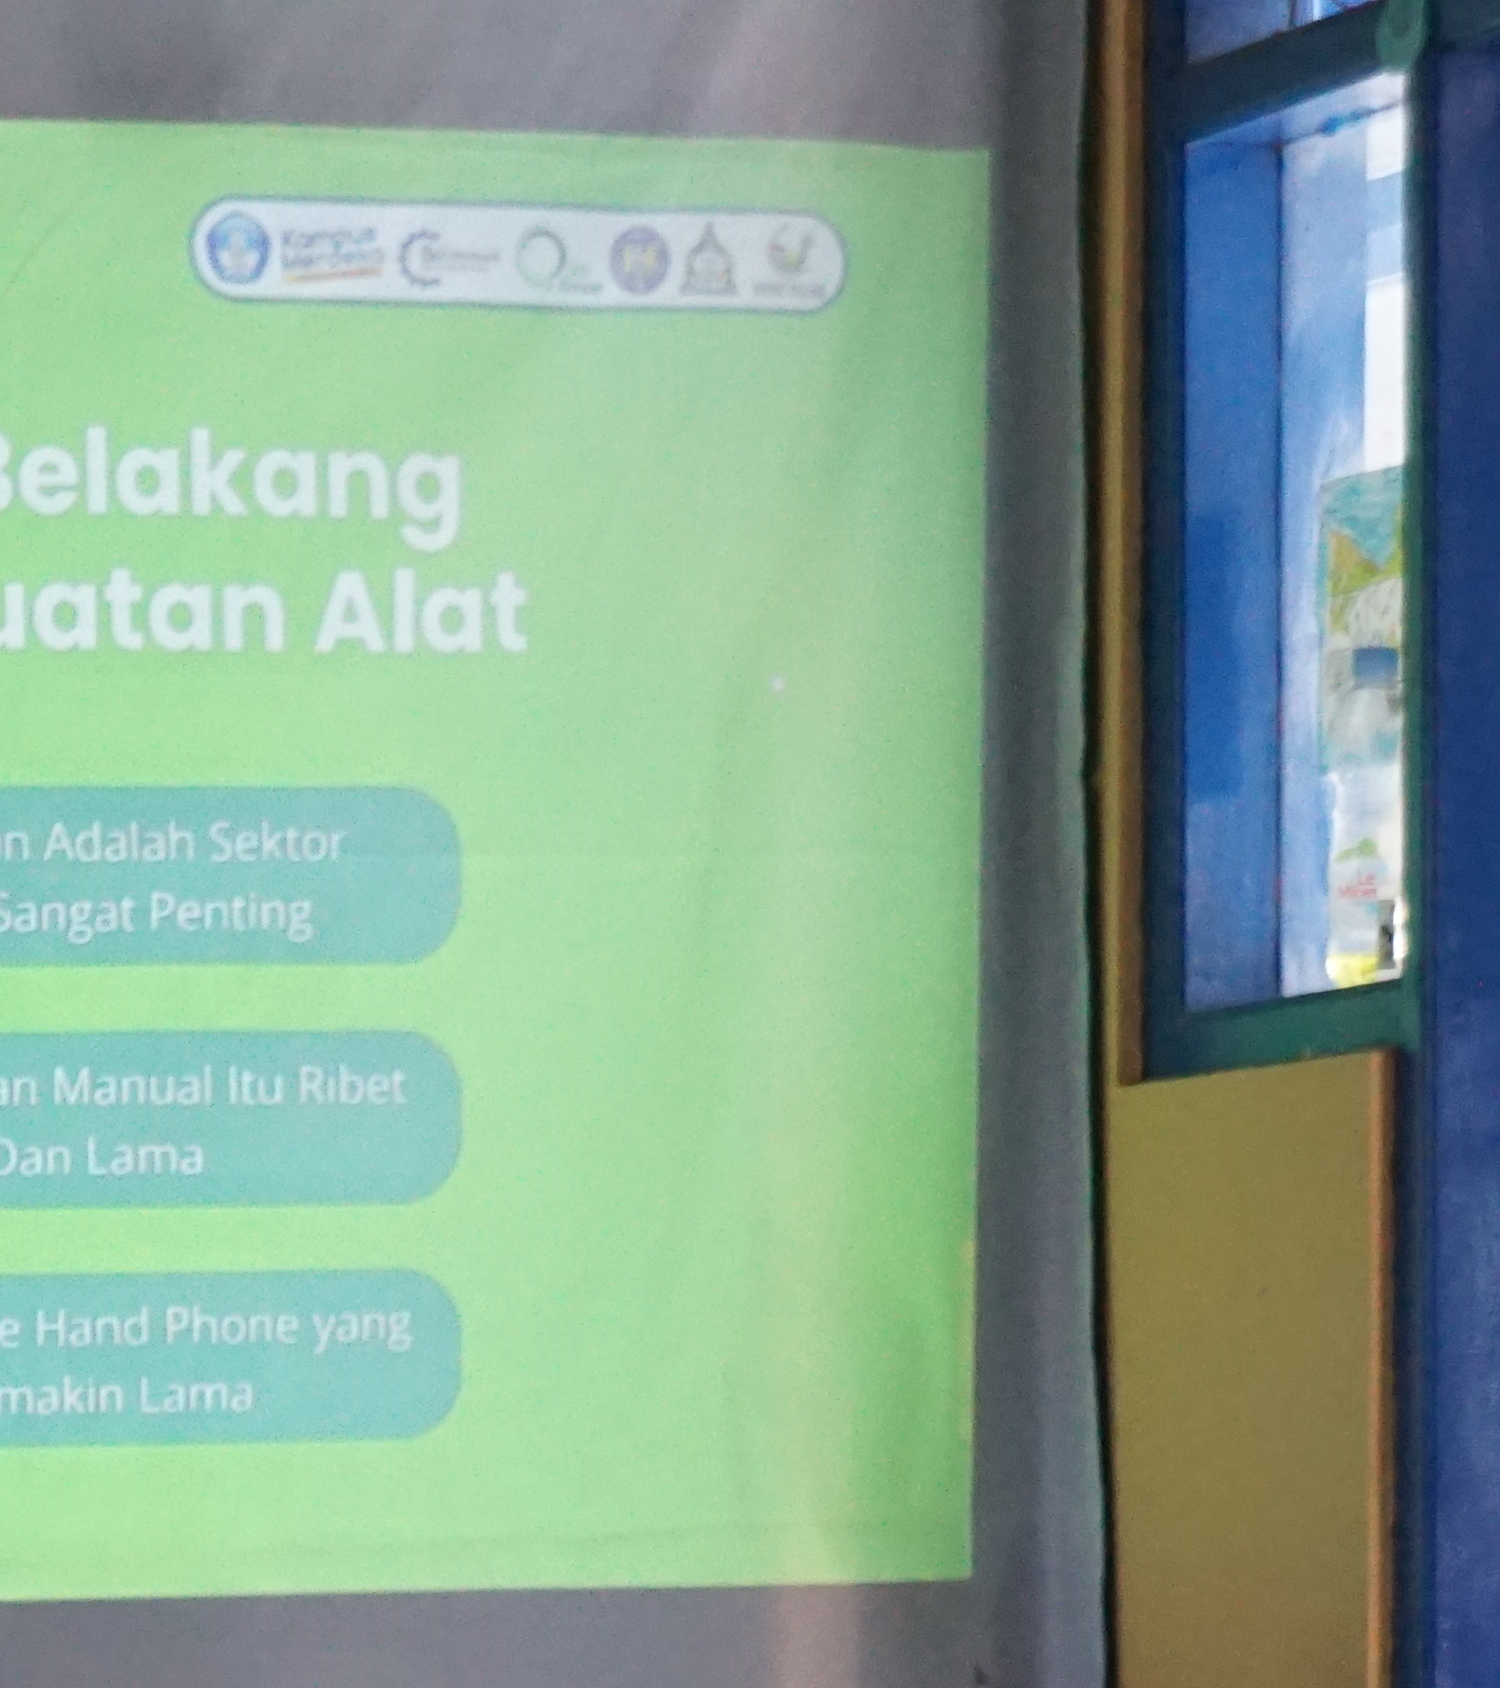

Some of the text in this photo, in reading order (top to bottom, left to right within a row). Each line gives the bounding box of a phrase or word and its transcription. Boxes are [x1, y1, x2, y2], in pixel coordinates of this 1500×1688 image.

[312, 567, 529, 654] Alat
[42, 819, 196, 864] Adalah
[208, 818, 348, 864] Sektor
[148, 890, 313, 943] Penting
[52, 1063, 213, 1108] Manual
[227, 1064, 284, 1107] Itu
[297, 1063, 406, 1106] Ribet
[87, 1135, 204, 1177] Lama
[35, 1305, 151, 1349] Hand
[165, 1303, 301, 1346] Phone
[310, 1307, 413, 1353] yang
[139, 1374, 256, 1414] Lama
